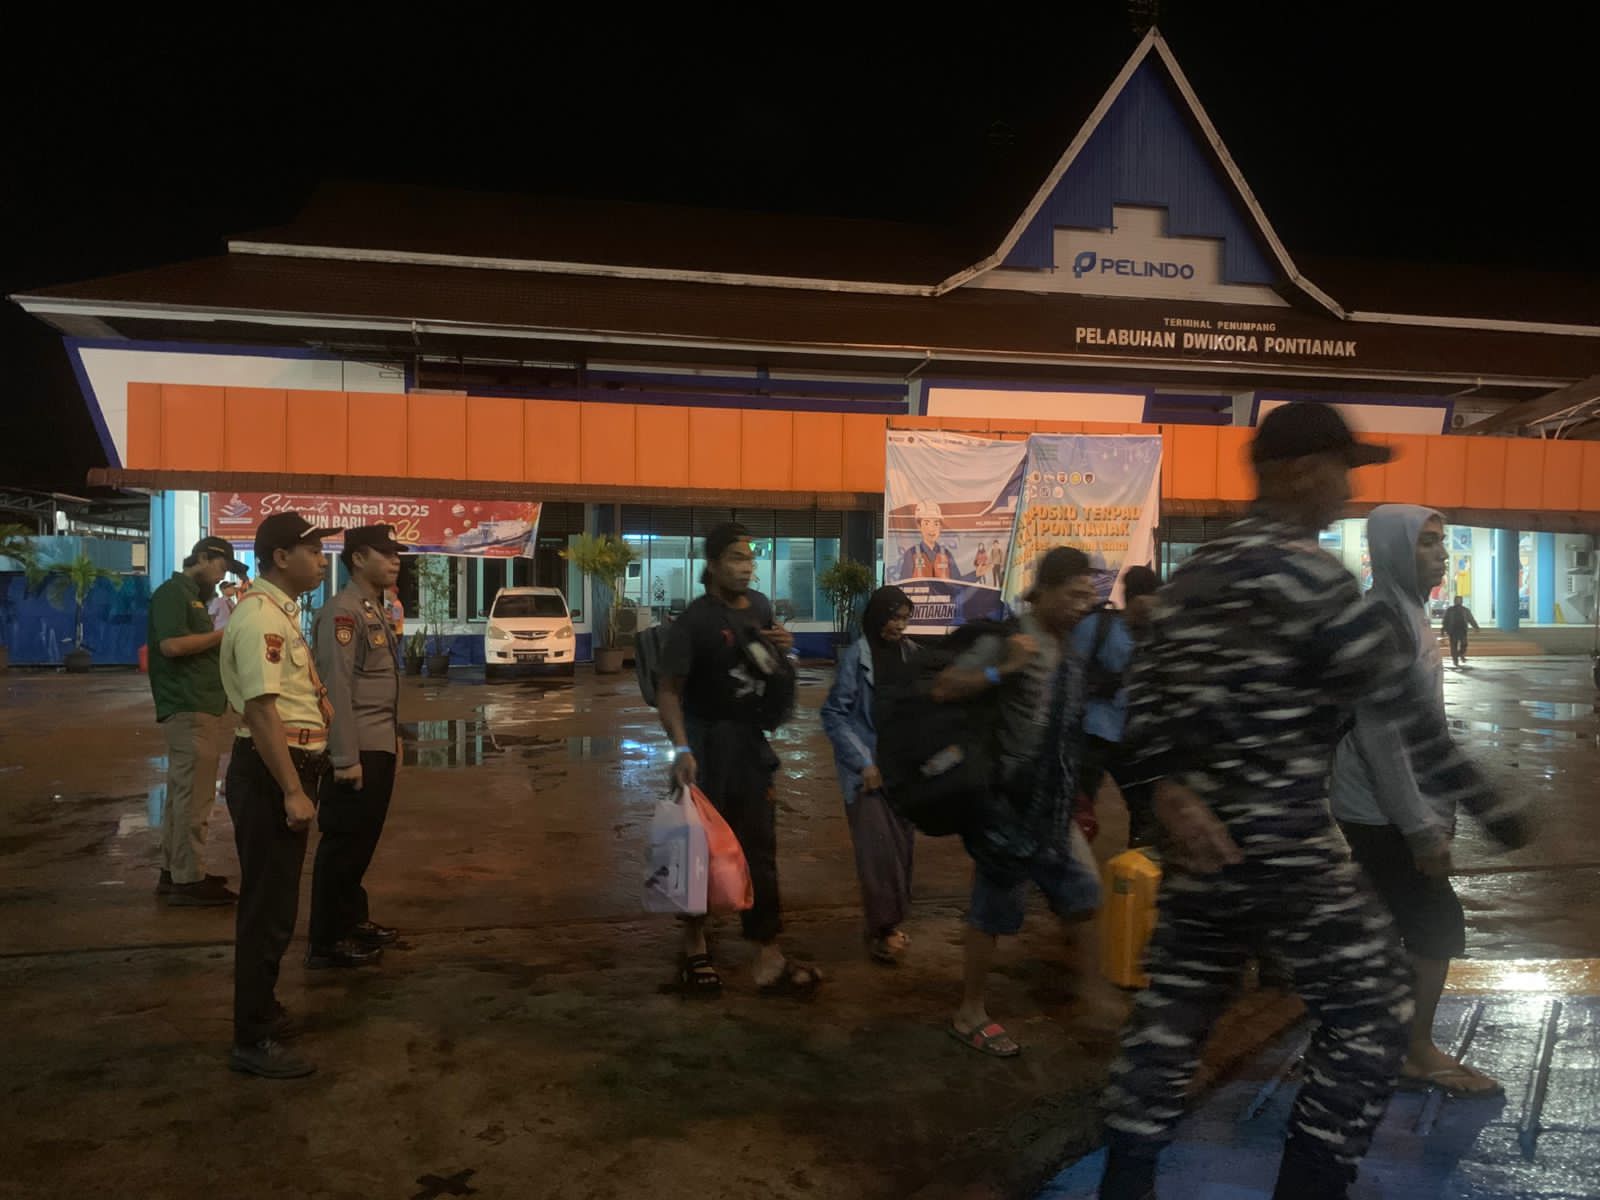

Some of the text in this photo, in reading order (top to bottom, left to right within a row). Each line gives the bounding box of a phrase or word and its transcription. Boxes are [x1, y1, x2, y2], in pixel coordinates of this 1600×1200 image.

[1100, 258, 1194, 280] PELINDO
[1164, 318, 1276, 332] TERMINAL PENUMPANG
[1076, 327, 1357, 357] PELABUHAN DWIKORA PONTIANAK
[260, 493, 331, 515] Selamat
[339, 502, 384, 515] Natal
[388, 503, 430, 517] 2025
